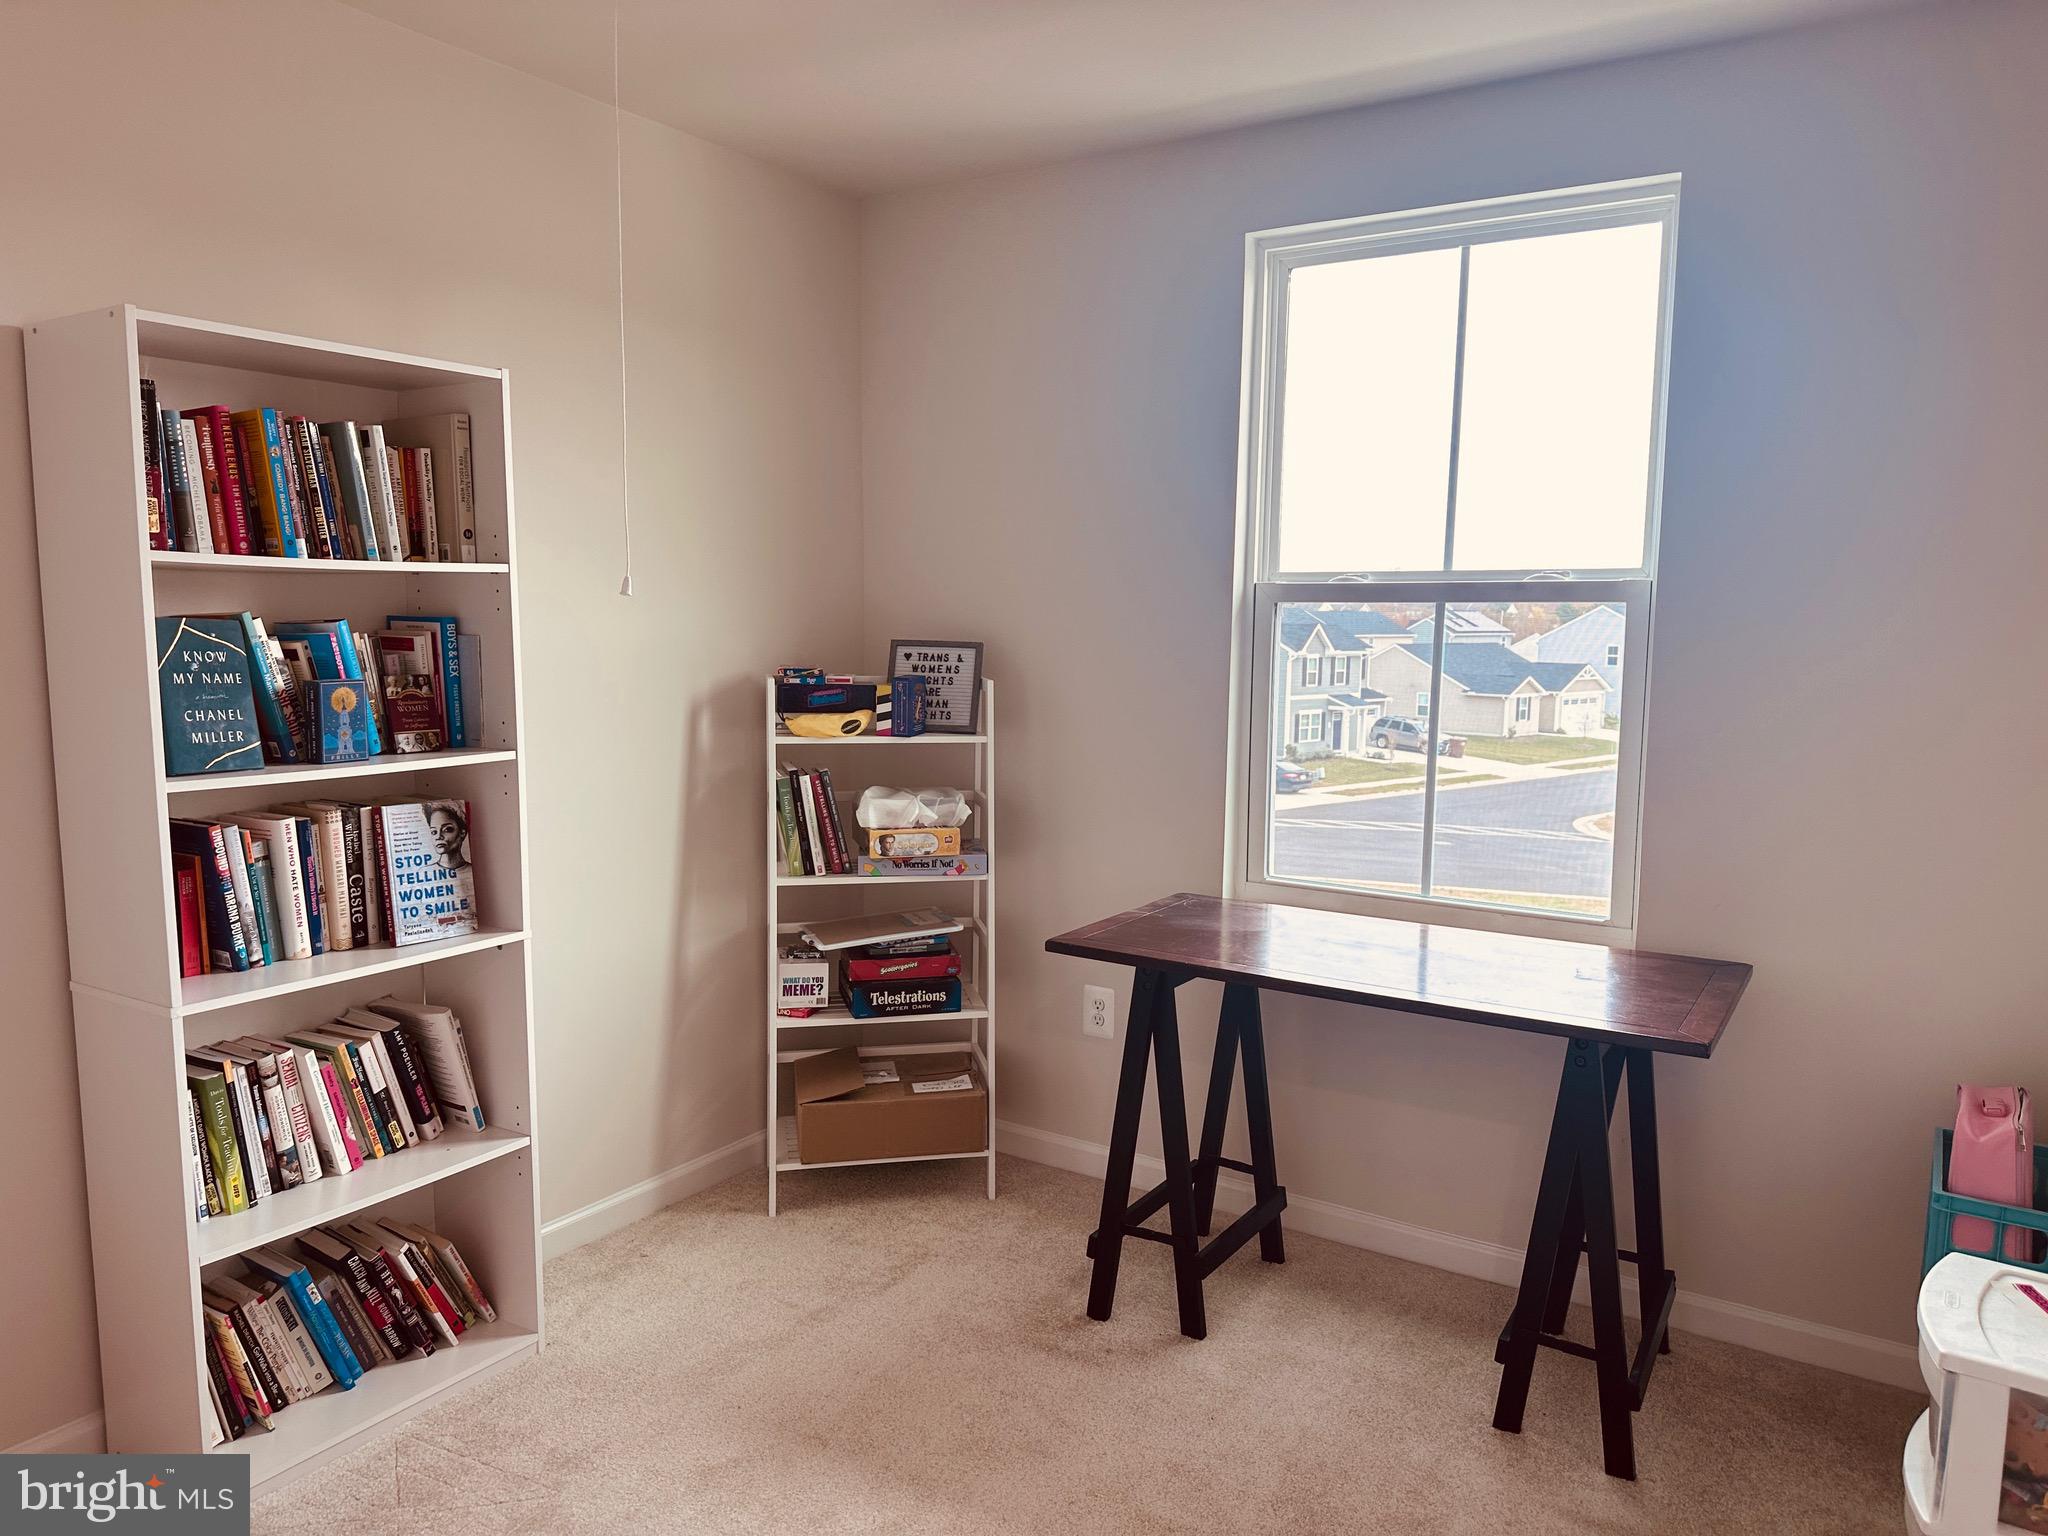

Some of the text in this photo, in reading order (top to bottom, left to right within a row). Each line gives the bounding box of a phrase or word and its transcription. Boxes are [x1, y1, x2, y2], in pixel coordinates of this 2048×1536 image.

[299, 422, 308, 447] SARAH
[184, 424, 193, 465] BECOMING
[191, 475, 199, 511] MICHELLE
[219, 410, 246, 537] IT NEVER ENDS TOM SCHARPLING
[274, 462, 283, 491] COMEDY
[292, 464, 300, 491] Sociology
[303, 447, 316, 489] SILVERMAN
[395, 476, 404, 515] AMERICANAH
[314, 505, 326, 539] BEDWETTER
[446, 623, 456, 648] BOYS
[183, 651, 227, 662] KNOW
[261, 640, 277, 684] MEGAN TWOHEY
[449, 658, 458, 677] SEX
[917, 652, 964, 662] TRANS &
[173, 673, 243, 684] MY NAME
[912, 664, 960, 674] WOMENS
[926, 676, 954, 685] GHTS
[263, 672, 276, 701] Manual
[277, 688, 299, 737] SHE SAID
[397, 704, 429, 712] WOMEN
[926, 700, 948, 708] MAN
[184, 710, 244, 722] CHANEL
[192, 731, 244, 743] MILLER
[819, 794, 827, 817] TELLING
[829, 838, 834, 846] TO
[344, 822, 354, 863] Wilkerson
[332, 827, 346, 919] UNBOWED WANGARI MAATHAI
[395, 854, 432, 869] STOP
[892, 859, 954, 869] No Worries If Not!
[397, 868, 457, 885] TELLING
[212, 828, 243, 952] UNBOUND TARANA BURKE
[349, 872, 365, 924] Caste
[398, 884, 454, 902] WOMEN
[294, 893, 302, 928] WOMEN
[385, 898, 390, 908] TO
[400, 898, 468, 919] TO SMILE
[880, 962, 918, 974] Scattergories
[782, 984, 823, 996] MEME?
[870, 990, 946, 1006] Telestrations
[393, 1030, 403, 1045] AMY
[401, 1048, 416, 1080] POEHLER
[415, 1083, 423, 1095] YES
[419, 1095, 431, 1115] PLEASE
[210, 1088, 224, 1096] Davis
[281, 1056, 297, 1089] SEXUAL
[292, 1103, 309, 1142] CITIZENS
[313, 1070, 322, 1090] Gender
[323, 1103, 332, 1122] Health
[333, 1092, 343, 1117] samantha
[214, 1097, 227, 1137] Tools for
[190, 1133, 198, 1156] EXCLUSION
[347, 1255, 400, 1348] CATCH AND KILL RONAN FARROW
[233, 1309, 245, 1328] RACHEL
[242, 1329, 254, 1347] DRATCH
[256, 1327, 265, 1338] The
[261, 1337, 273, 1354] Color
[252, 1346, 262, 1357] Girl
[256, 1356, 269, 1372] Walks
[264, 1371, 273, 1381] into
